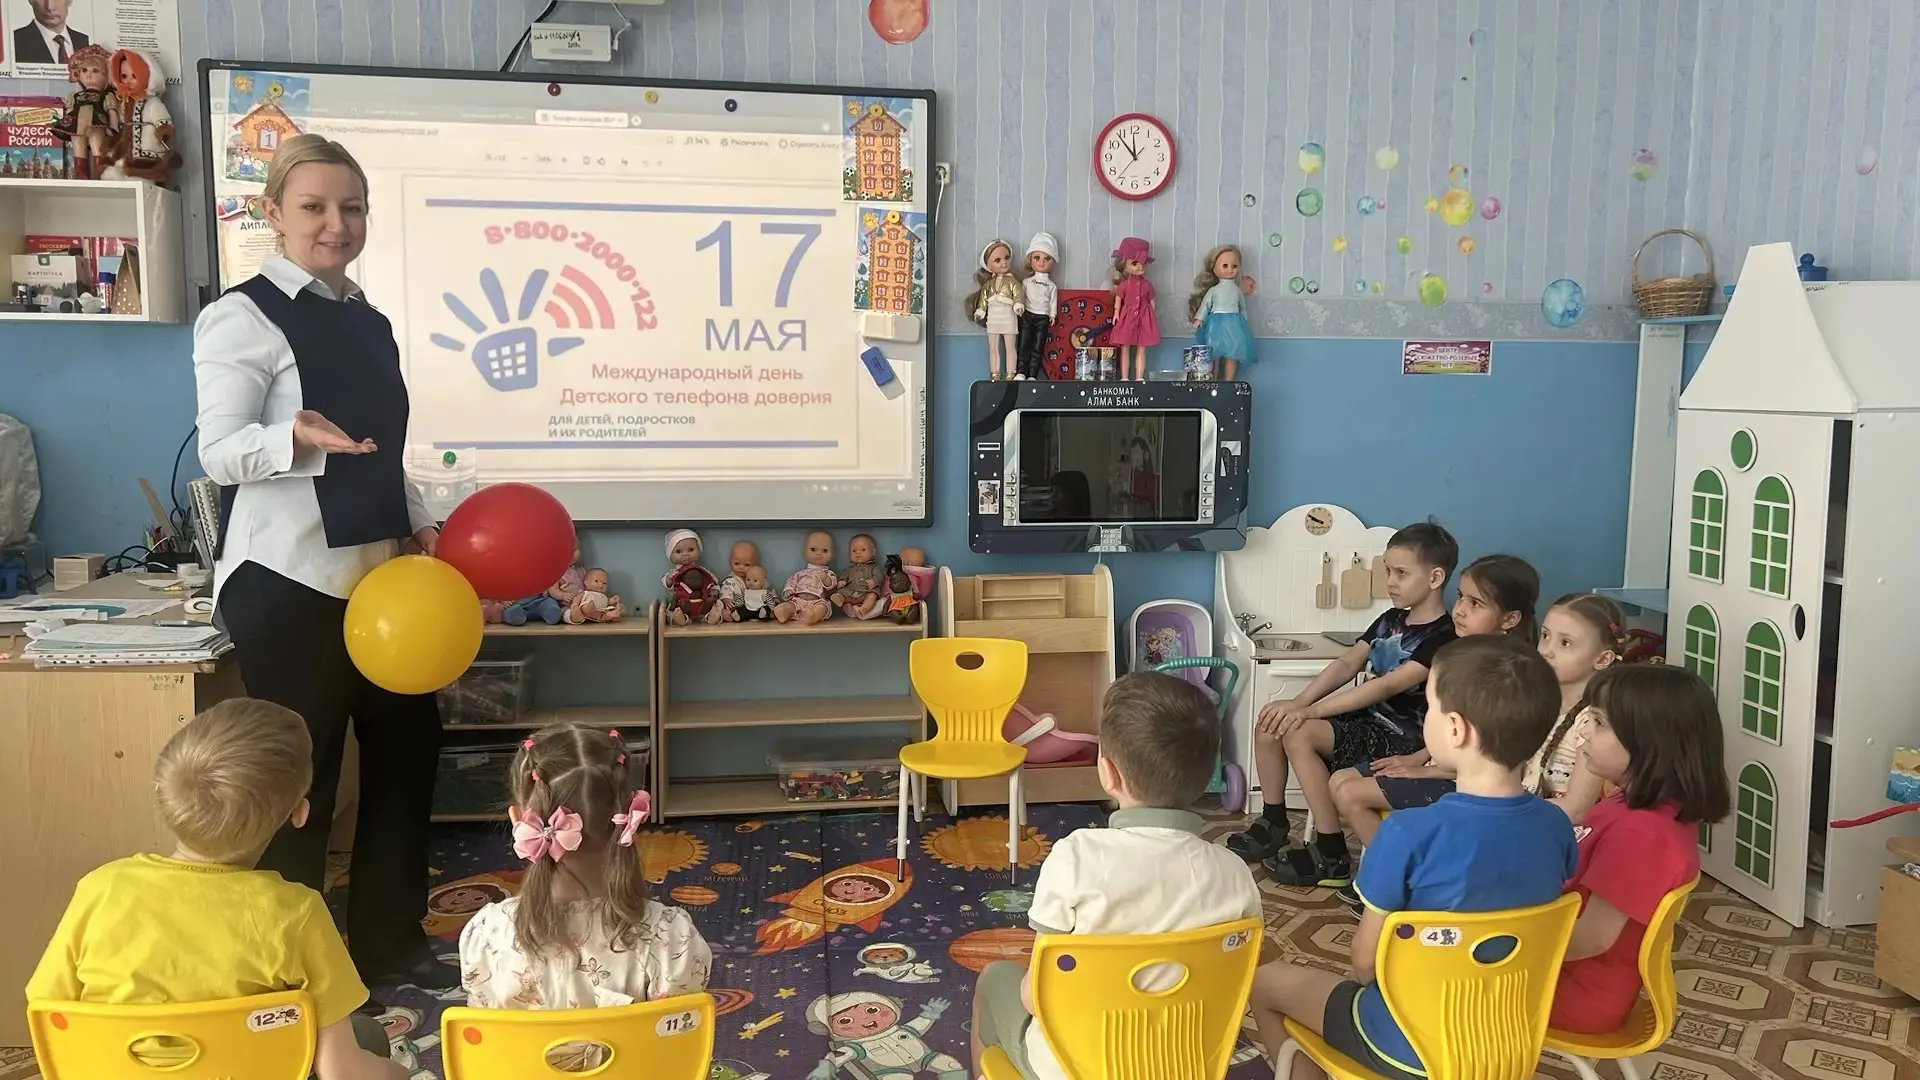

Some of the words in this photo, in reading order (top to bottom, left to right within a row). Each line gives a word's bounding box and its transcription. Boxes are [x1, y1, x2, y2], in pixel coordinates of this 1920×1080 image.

[1119, 129, 1126, 138] 11
[1130, 125, 1140, 135] 12
[264, 134, 273, 147] 1
[1109, 140, 1120, 150] 10
[1154, 139, 1161, 148] 2
[1104, 153, 1113, 162] 9
[1157, 153, 1165, 162] 3
[1109, 166, 1117, 176] 8
[1153, 167, 1160, 176] 4
[1118, 177, 1126, 186] 7
[1130, 180, 1139, 190] 6
[1143, 177, 1151, 187] 5
[695, 220, 822, 308] 17
[705, 318, 807, 351] МАЯ
[591, 363, 753, 383] Международный
[758, 366, 804, 381] день
[1093, 387, 1134, 396] БАНКОМАТ
[560, 388, 649, 405] Детского
[654, 389, 749, 407] телефона
[754, 391, 833, 407] доверия
[1087, 396, 1113, 406] АЛМА
[1116, 396, 1140, 406] БАНК
[548, 415, 573, 426] ДЛЯ
[617, 415, 696, 426] ПОДРОСТКОВ
[548, 428, 558, 438] И
[560, 428, 577, 438] ИХ
[579, 426, 647, 438] РОДИТЕЛЕЙ
[1227, 935, 1237, 947] 8
[1427, 931, 1439, 942] 4
[254, 1012, 276, 1027] 12
[665, 1018, 679, 1032] 11
